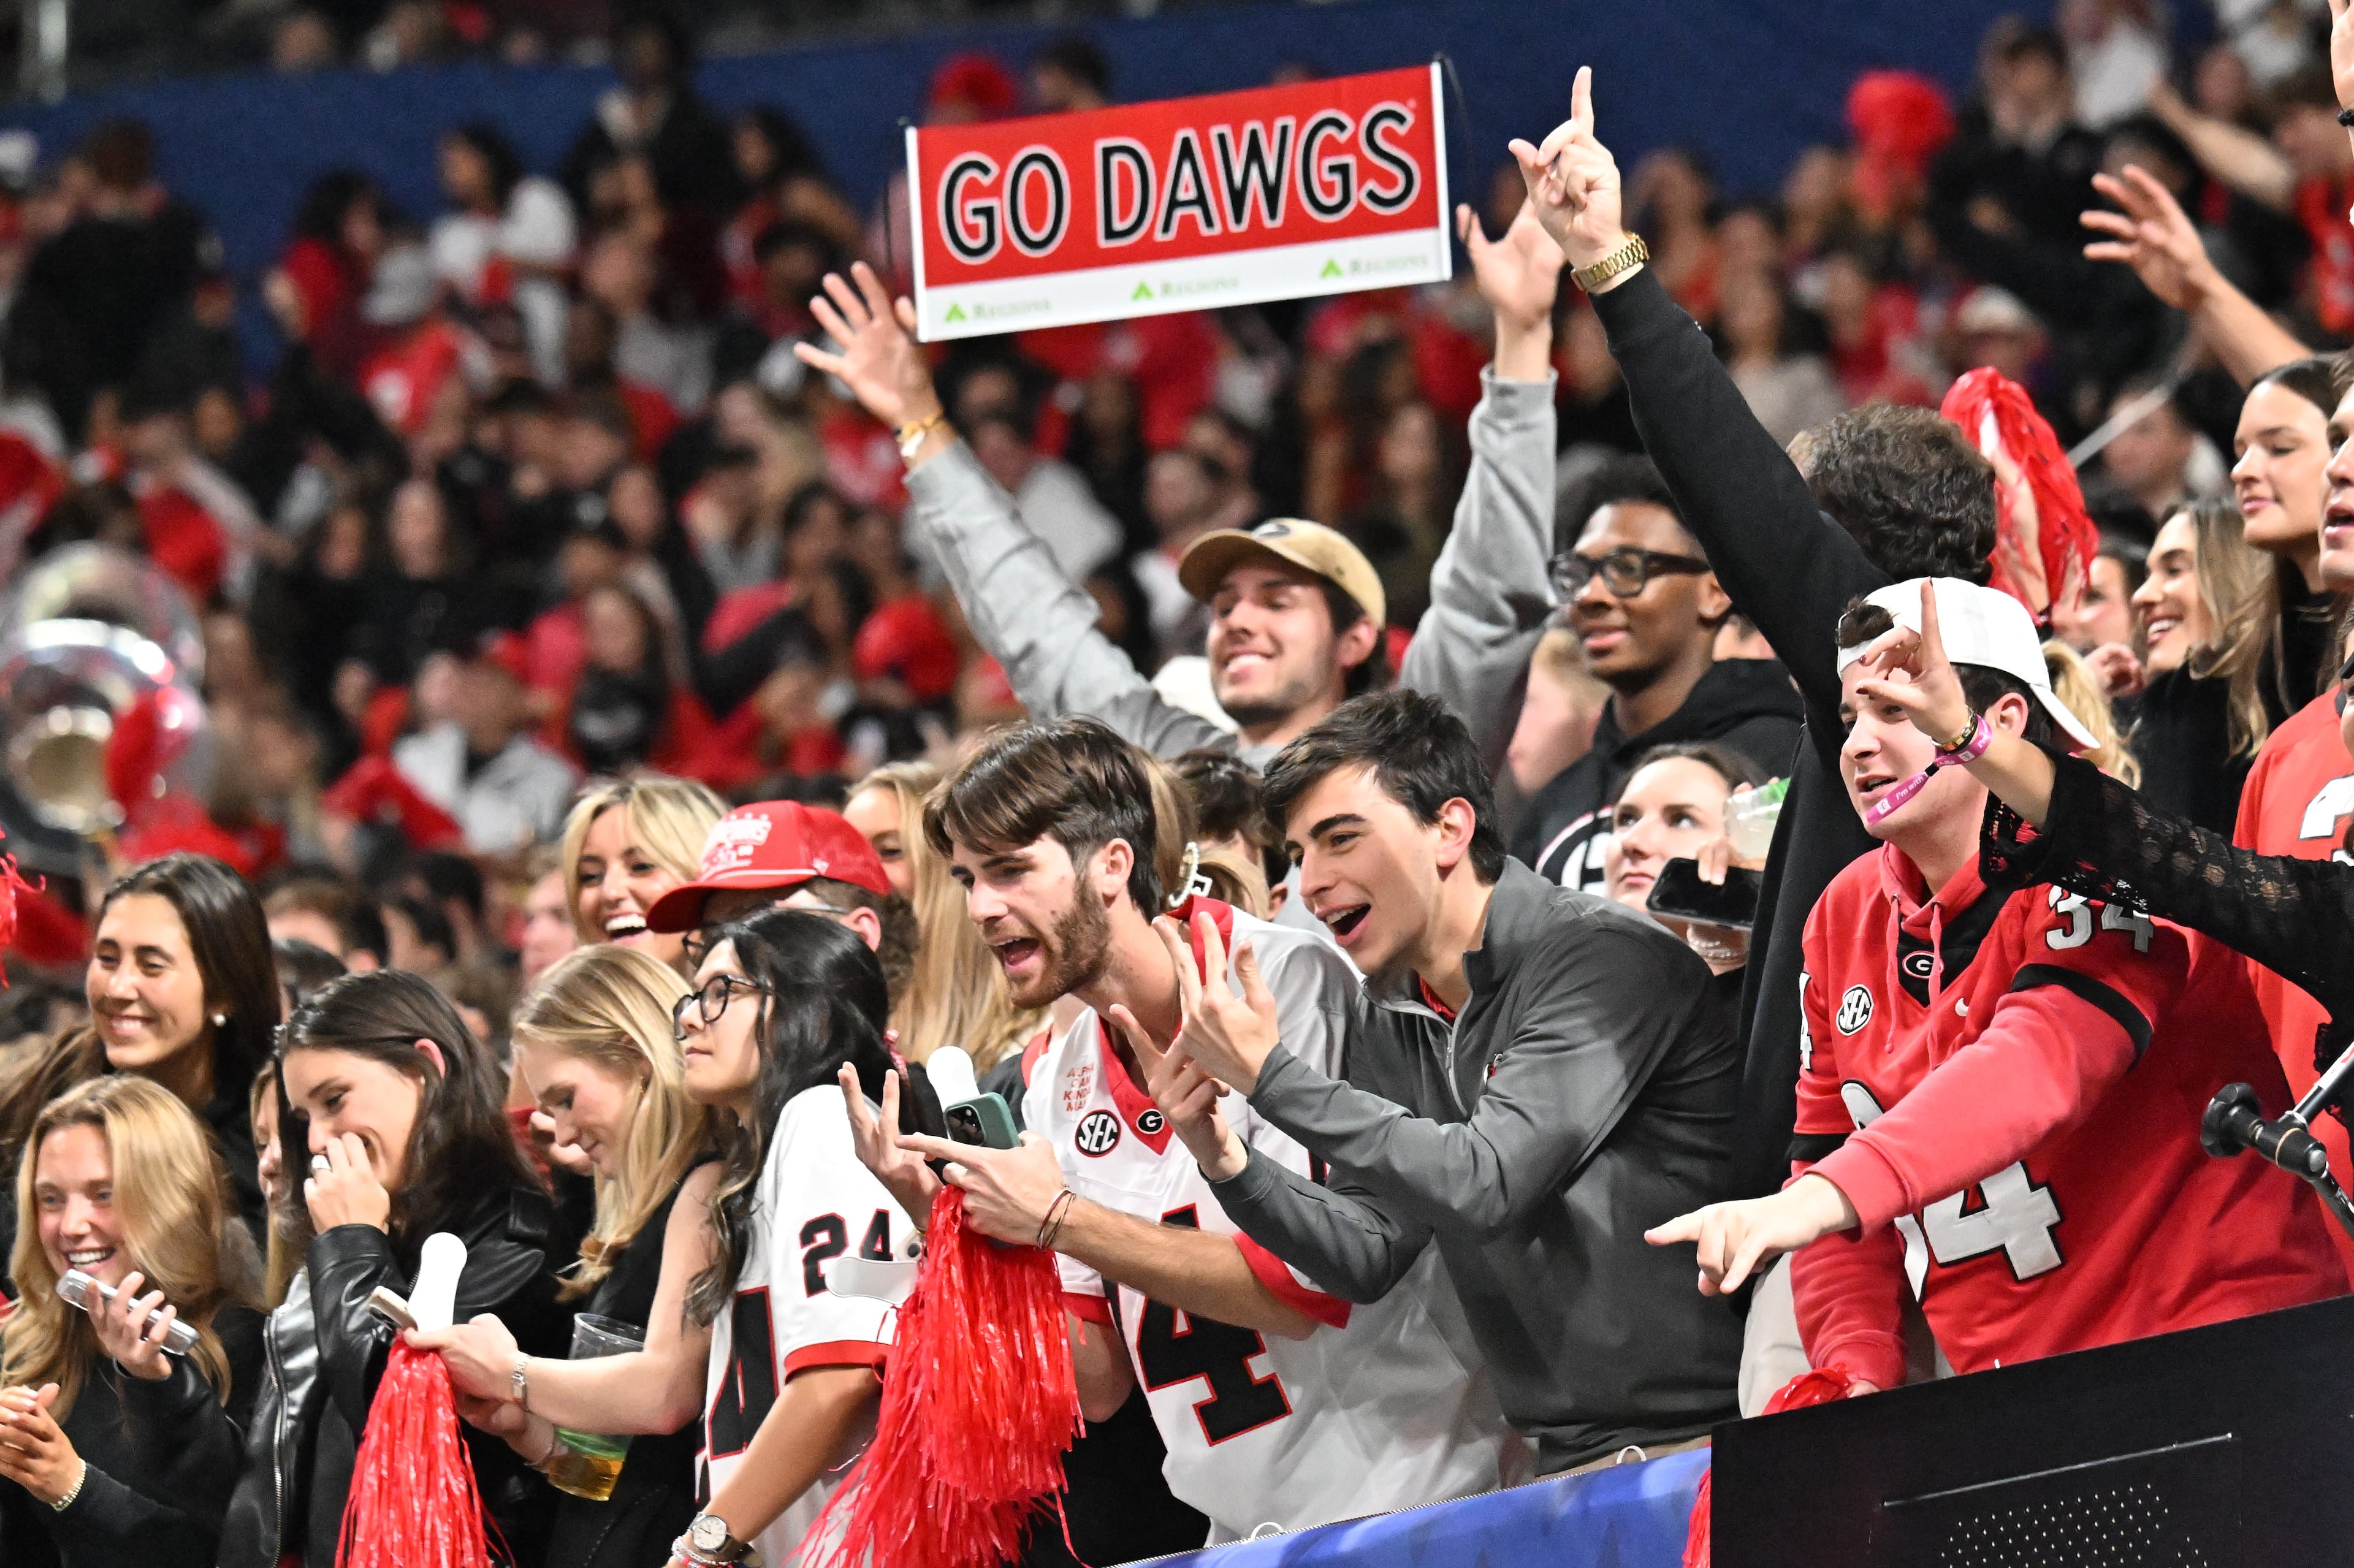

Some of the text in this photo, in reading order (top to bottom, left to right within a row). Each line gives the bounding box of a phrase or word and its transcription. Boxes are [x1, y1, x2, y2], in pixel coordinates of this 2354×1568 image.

[938, 101, 1420, 264] GO DAWGS
[1895, 788, 1908, 800] I'm
[1908, 775, 1924, 791] with
[1838, 988, 1871, 1031] SEC
[1078, 1113, 1118, 1153] SEC
[799, 1205, 894, 1299] 24
